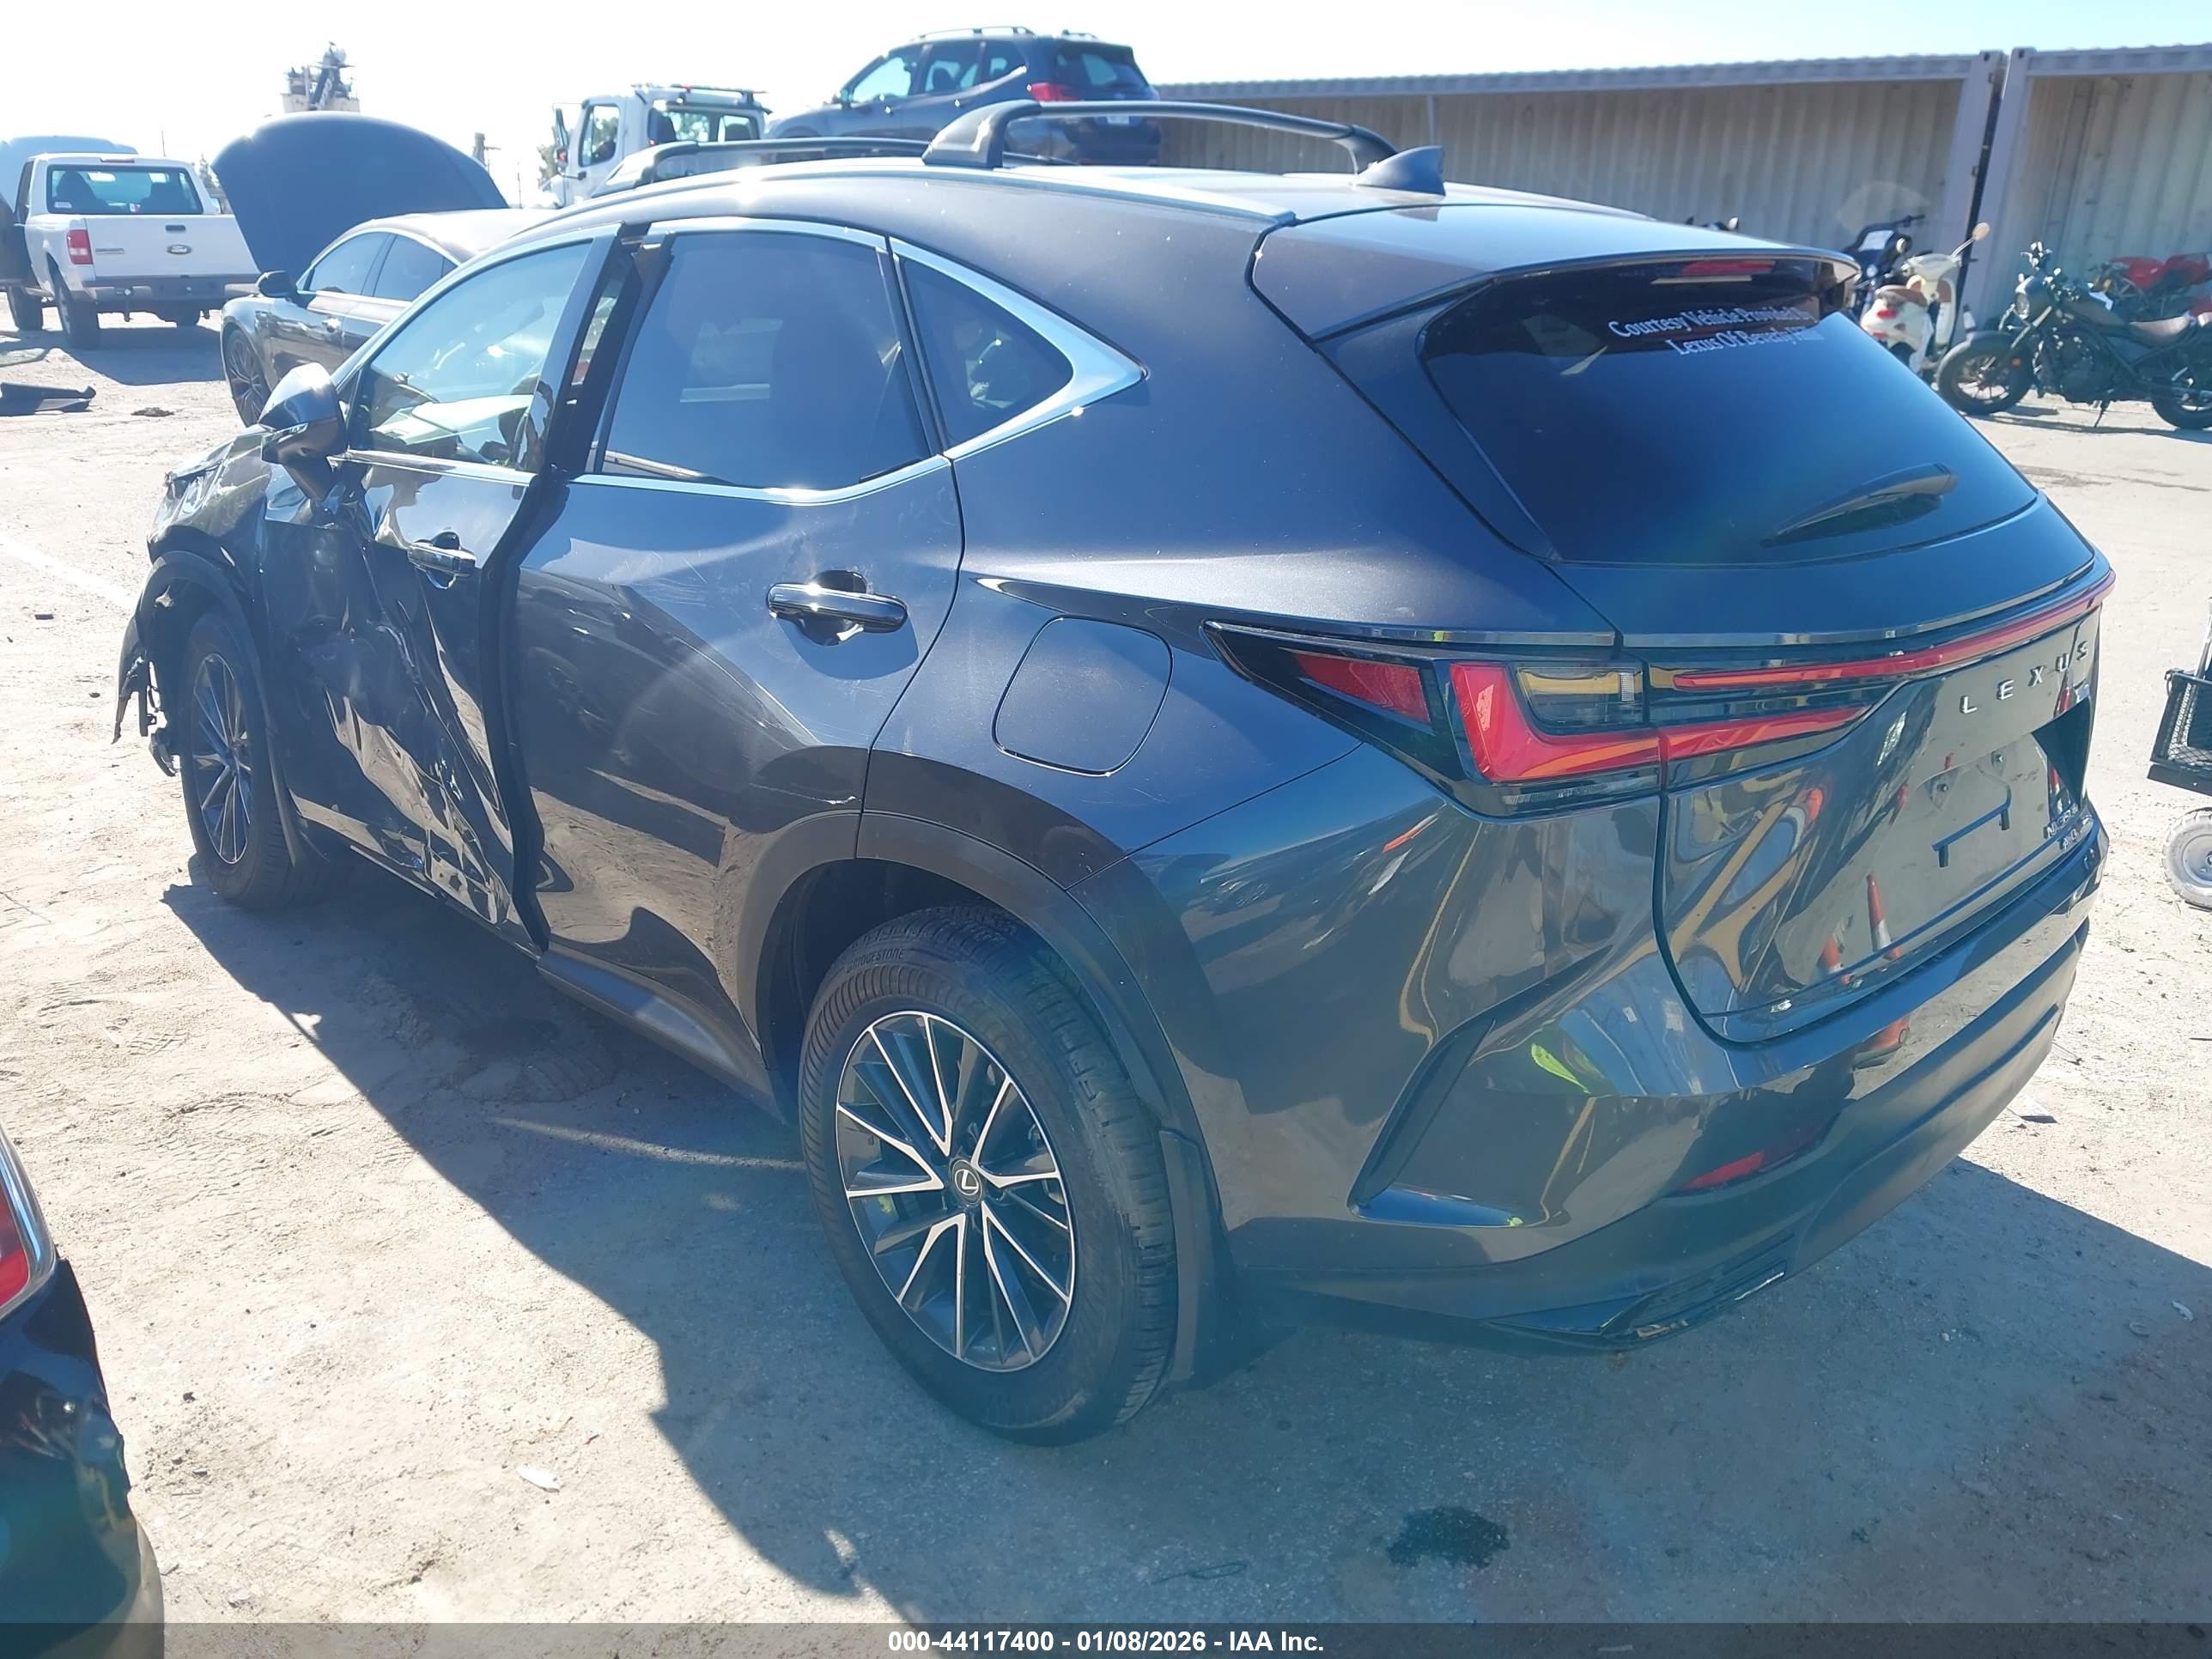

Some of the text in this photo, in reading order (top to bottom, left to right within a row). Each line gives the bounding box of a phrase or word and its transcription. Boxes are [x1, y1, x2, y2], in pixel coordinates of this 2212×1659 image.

[1608, 317, 1692, 337] Courtesy
[1680, 308, 1743, 327] Vehicle
[1665, 336, 1723, 355] Lexus
[1716, 331, 1743, 348] Of
[1960, 641, 2089, 714] LEXUS
